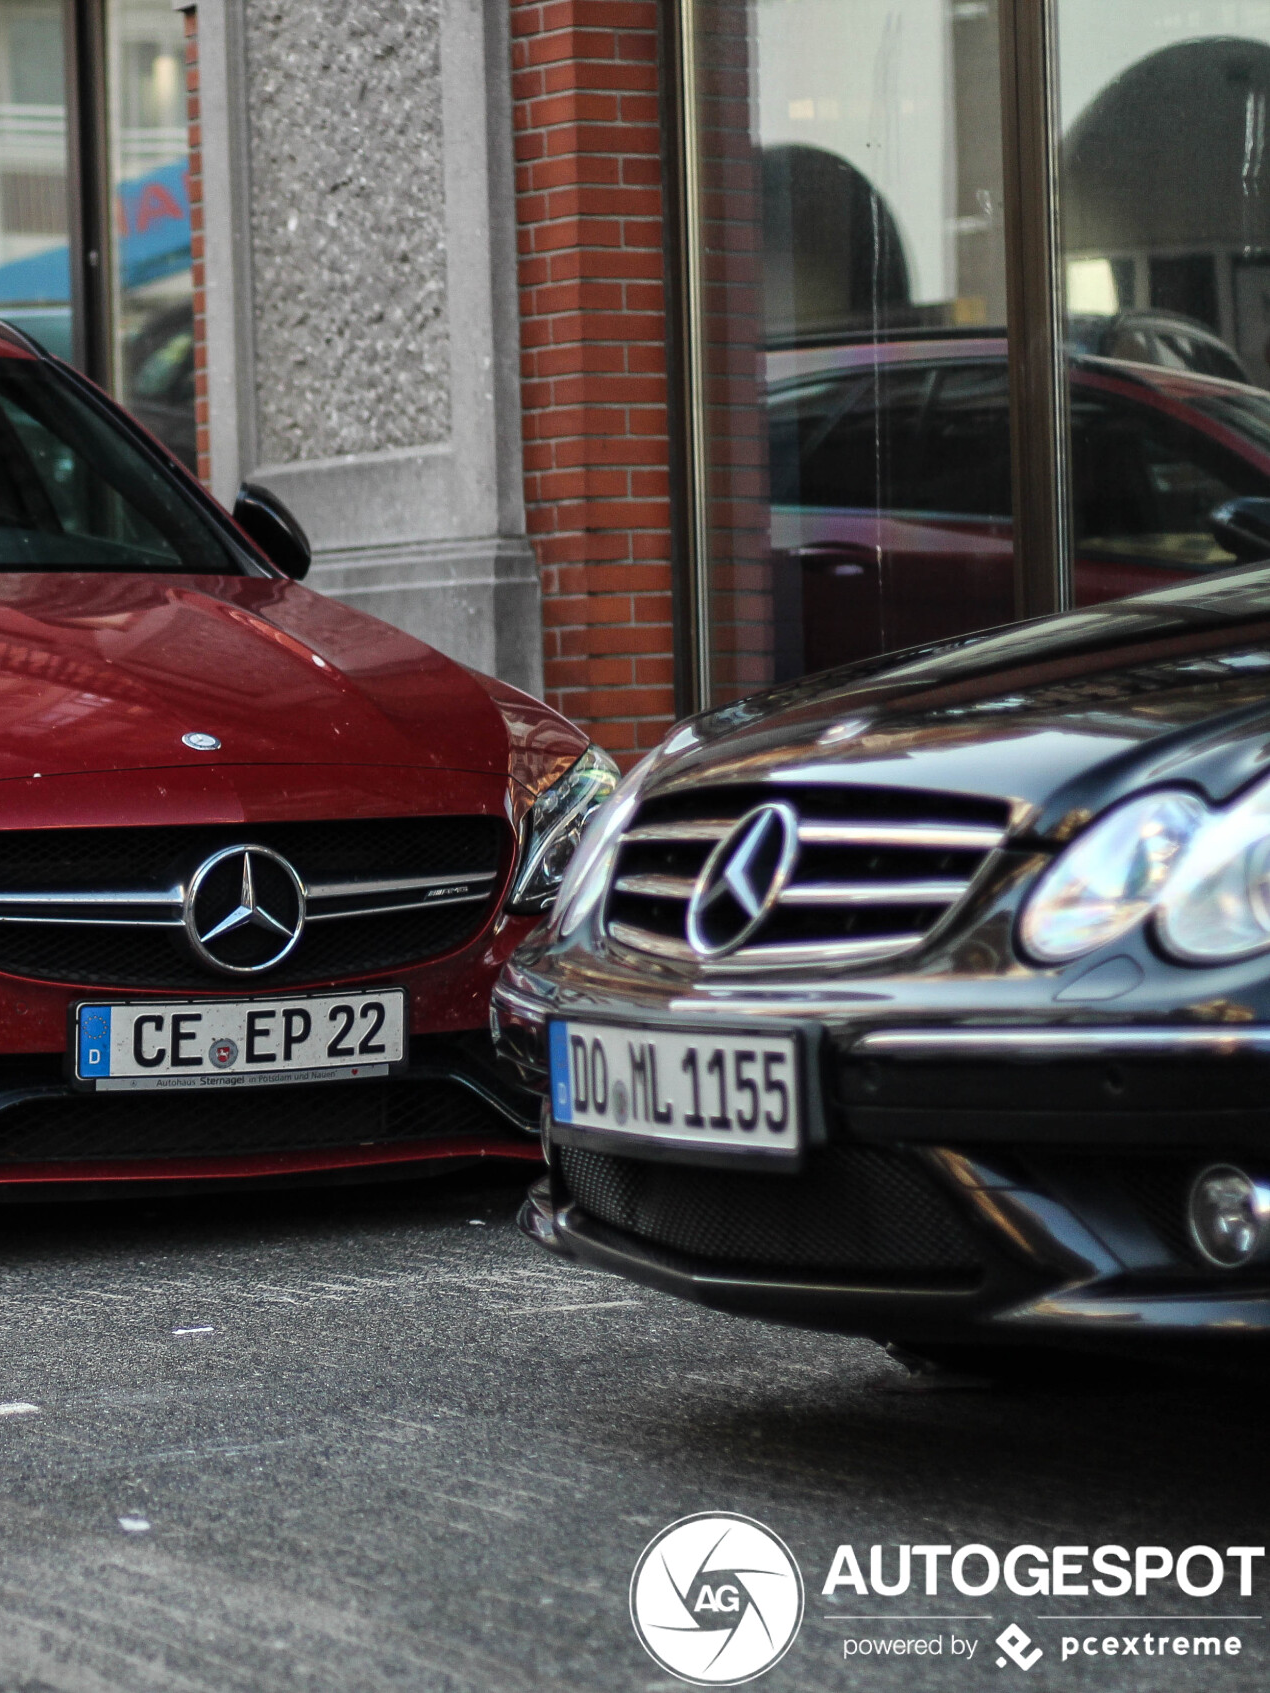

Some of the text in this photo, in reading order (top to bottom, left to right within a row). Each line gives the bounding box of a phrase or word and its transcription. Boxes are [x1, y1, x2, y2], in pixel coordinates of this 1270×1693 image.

[132, 1001, 386, 1067] CE EP 22
[88, 1049, 101, 1064] D
[156, 1078, 196, 1087] Autohaus
[200, 1076, 244, 1085] Sternagel
[259, 1073, 292, 1083] Potsdam
[294, 1072, 308, 1080] und
[311, 1071, 335, 1079] Nauen
[571, 1034, 792, 1137] DO ML 1155
